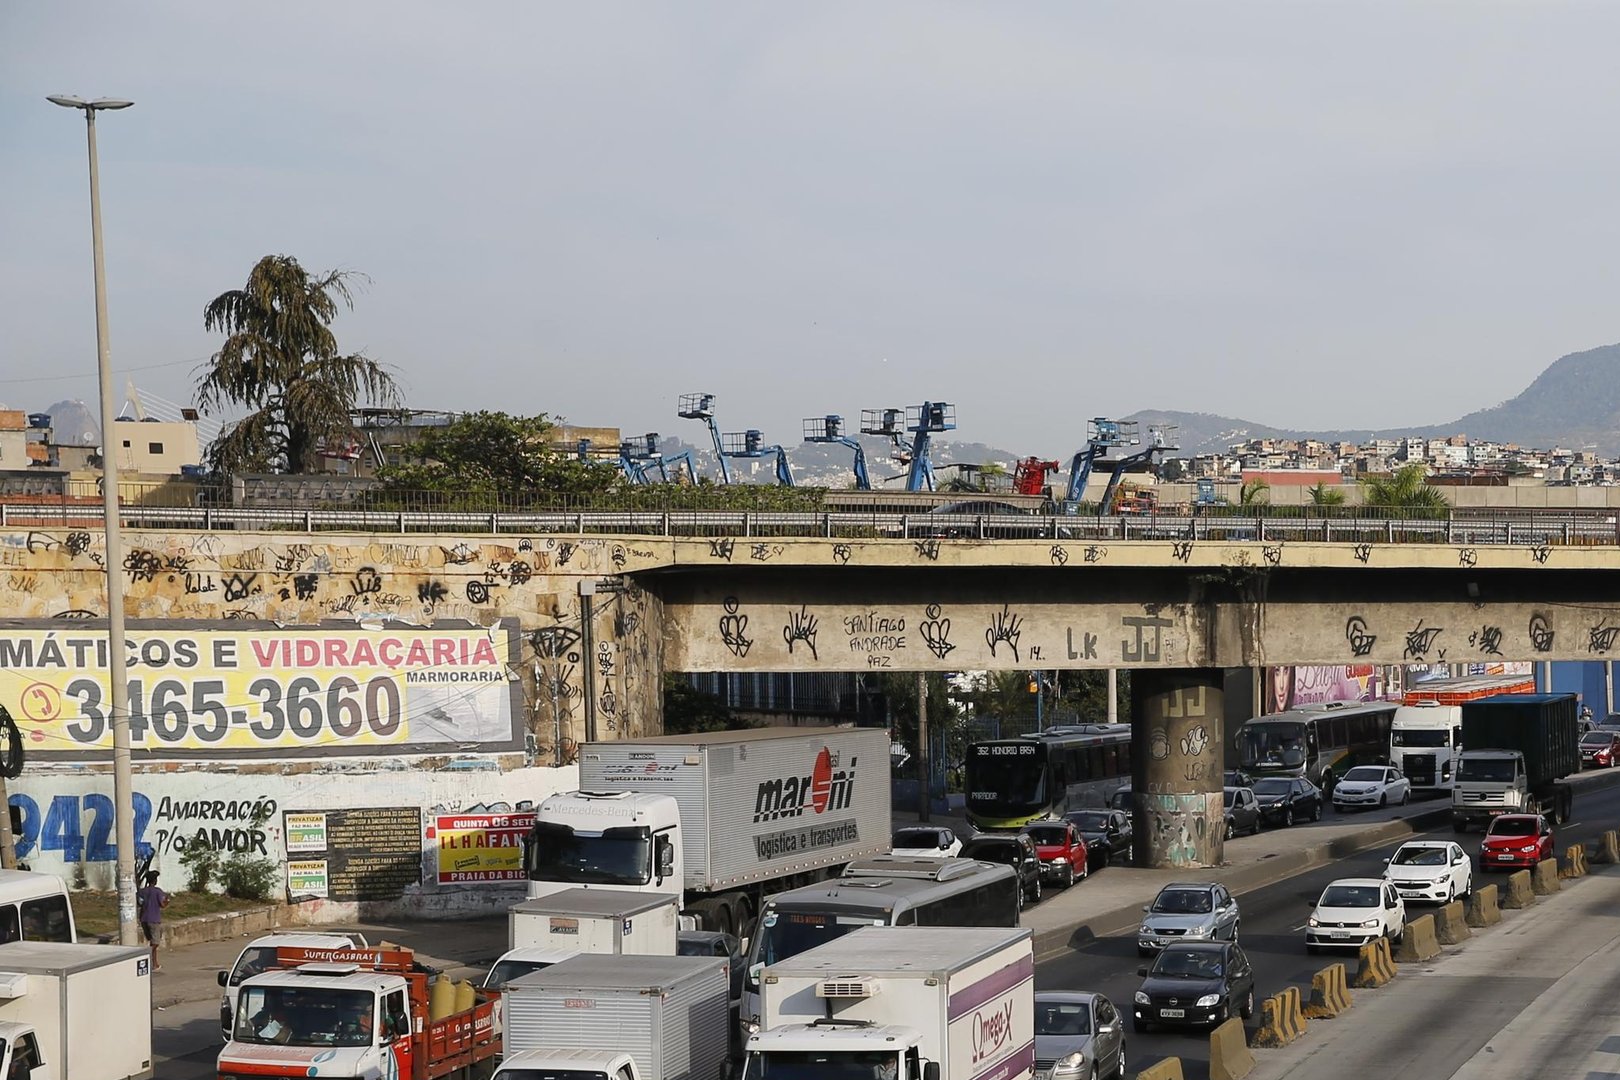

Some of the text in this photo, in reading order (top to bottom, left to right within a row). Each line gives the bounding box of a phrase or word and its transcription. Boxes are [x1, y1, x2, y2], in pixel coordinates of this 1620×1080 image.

[843, 610, 906, 635] SANTIAGO
[849, 635, 907, 652] ANDRADE
[213, 640, 237, 668] E
[251, 638, 498, 670] VIDRAÇARIA
[867, 655, 892, 668] PAZ
[407, 671, 503, 683] MARMORARIA
[66, 675, 401, 743] 3465-3660
[156, 795, 278, 823] AMARRAÇÃO
[550, 804, 634, 818] Mercedes-Benz
[453, 819, 490, 828] QUINTA
[492, 816, 509, 827] 06
[195, 827, 268, 856] AMOR
[289, 832, 324, 843] BRASIL
[800, 833, 807, 848] e
[451, 872, 486, 881] PRAIA
[489, 871, 503, 880] DA
[290, 879, 326, 889] BRASIL
